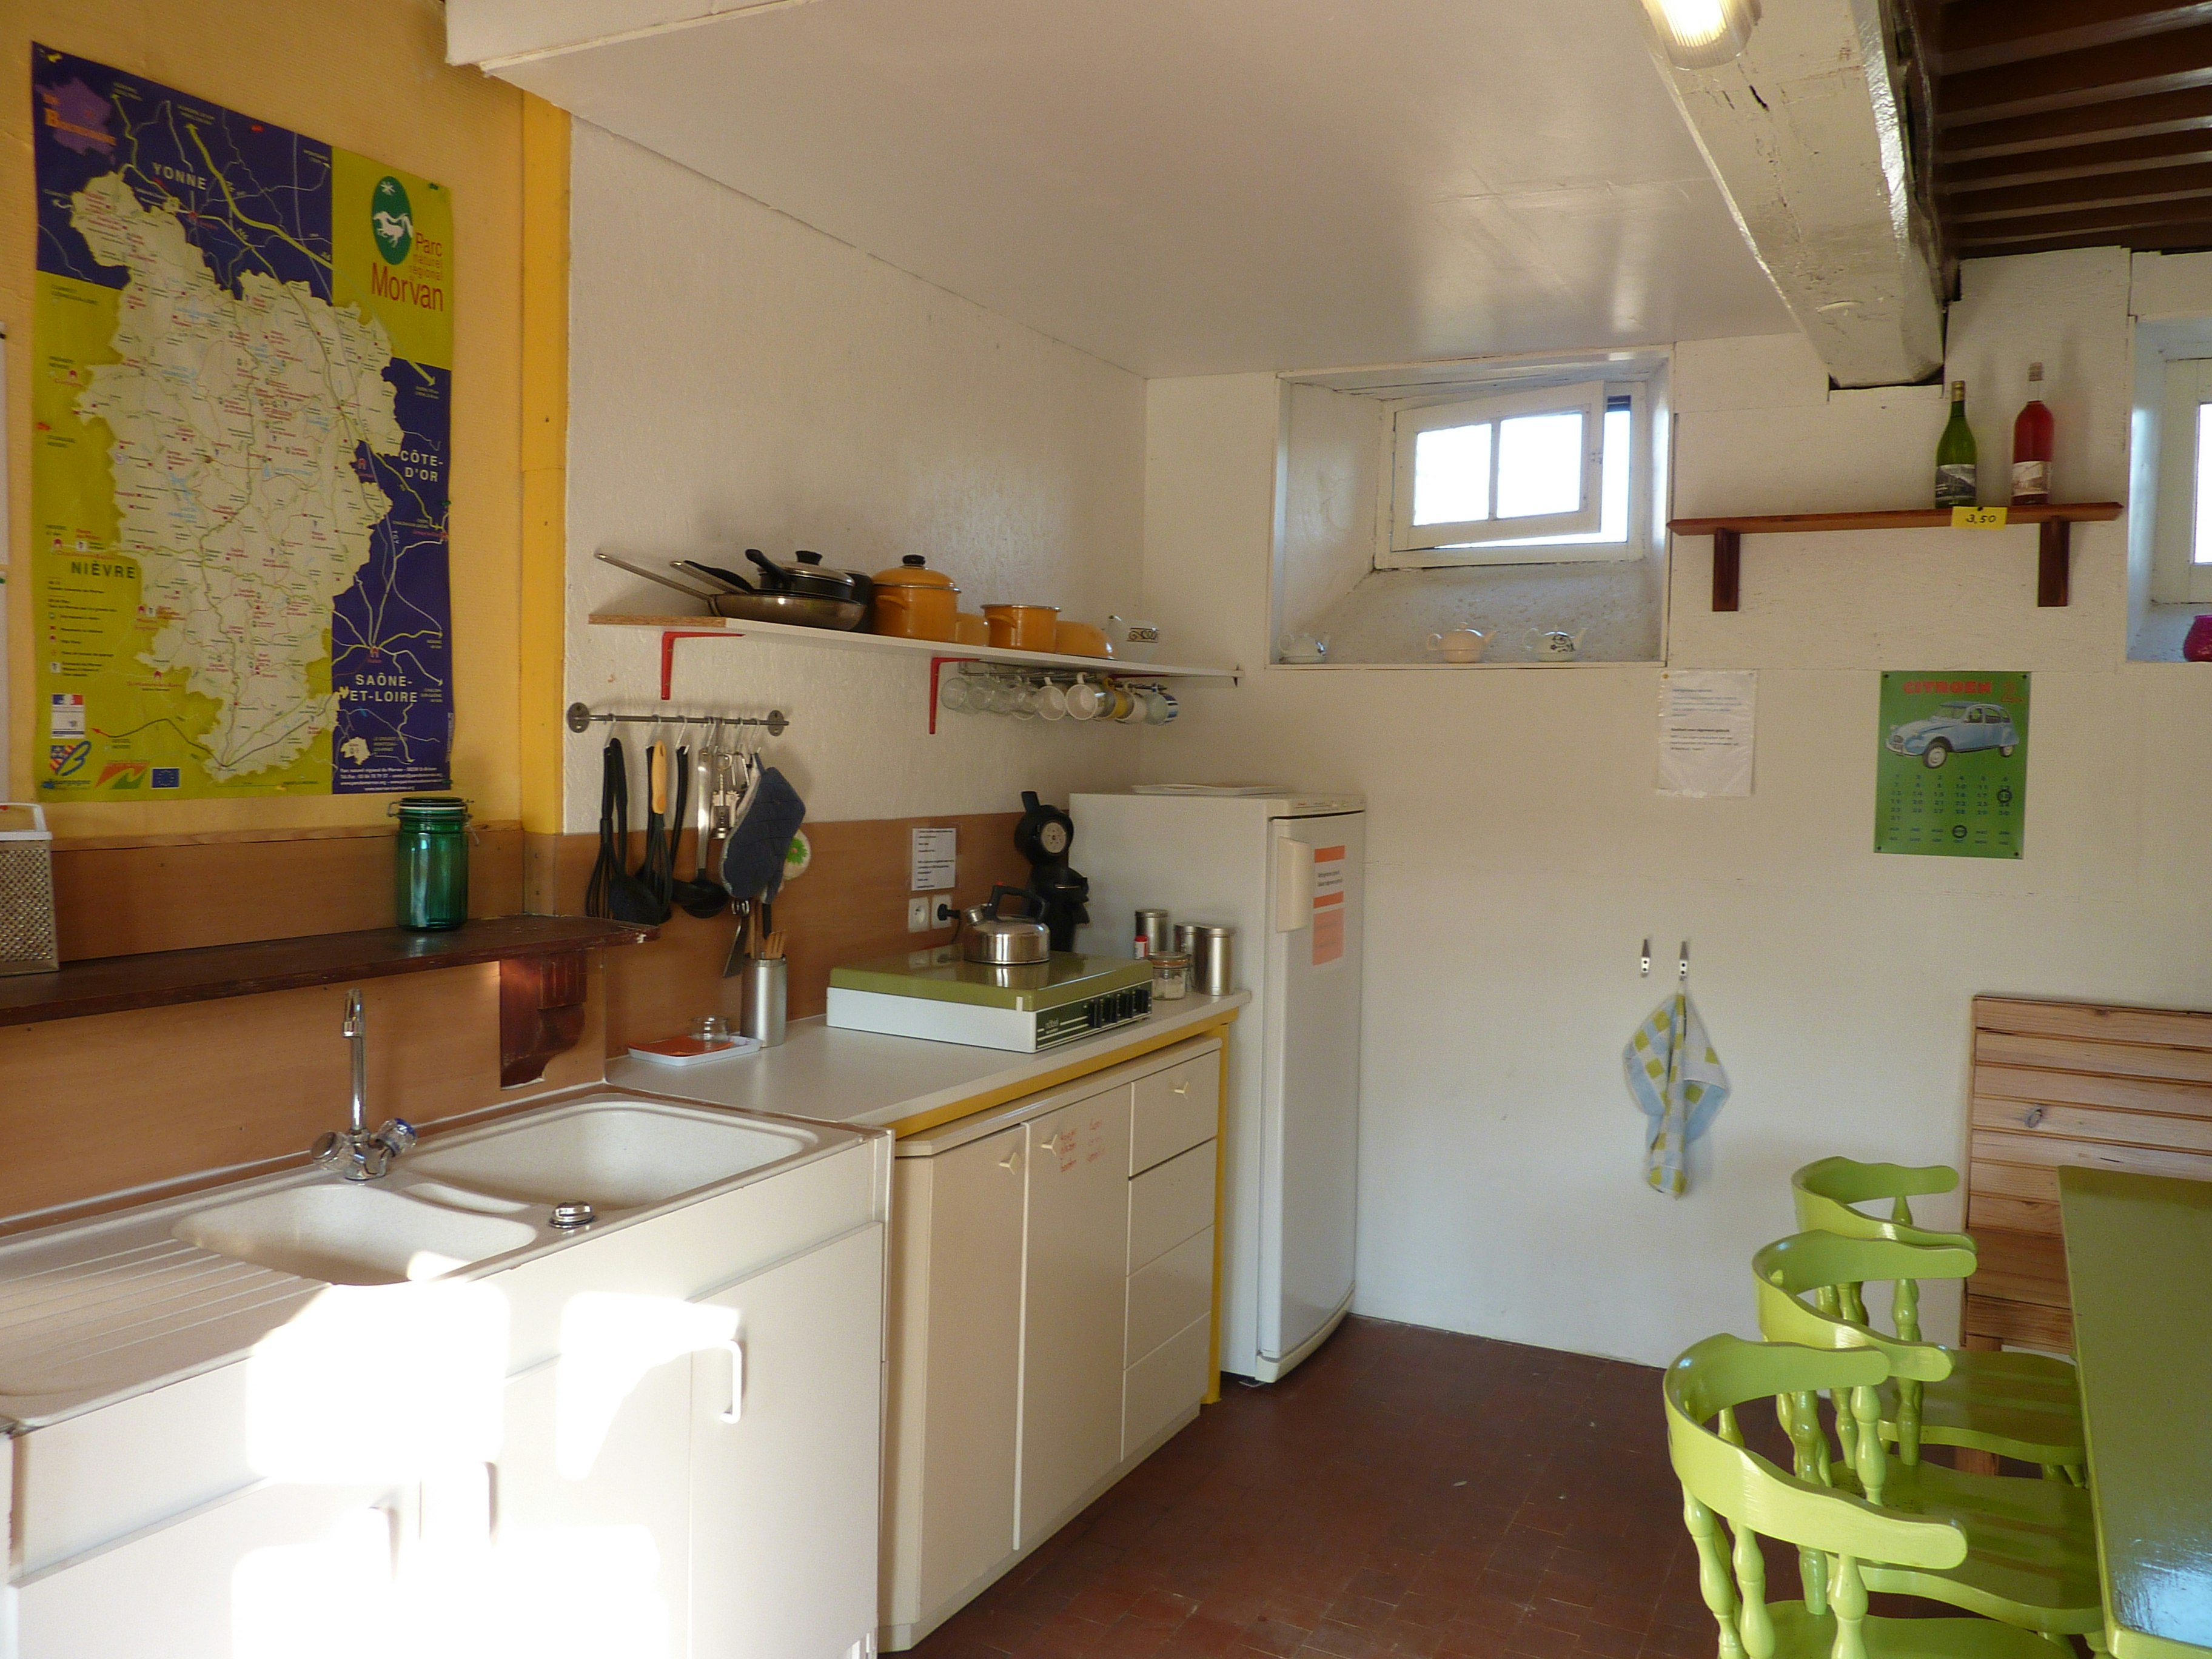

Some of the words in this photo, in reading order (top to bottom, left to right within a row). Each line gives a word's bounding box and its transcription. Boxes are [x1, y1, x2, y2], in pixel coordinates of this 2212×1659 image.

[153, 161, 207, 190] YONNE
[415, 232, 443, 256] Parc
[372, 263, 444, 312] Morvan
[400, 449, 443, 466] CÔTE-
[404, 467, 438, 482] D'OR
[71, 560, 136, 578] NIÈVRE
[355, 672, 413, 687] SAÔNE-
[349, 690, 418, 703] ET-LOIRE
